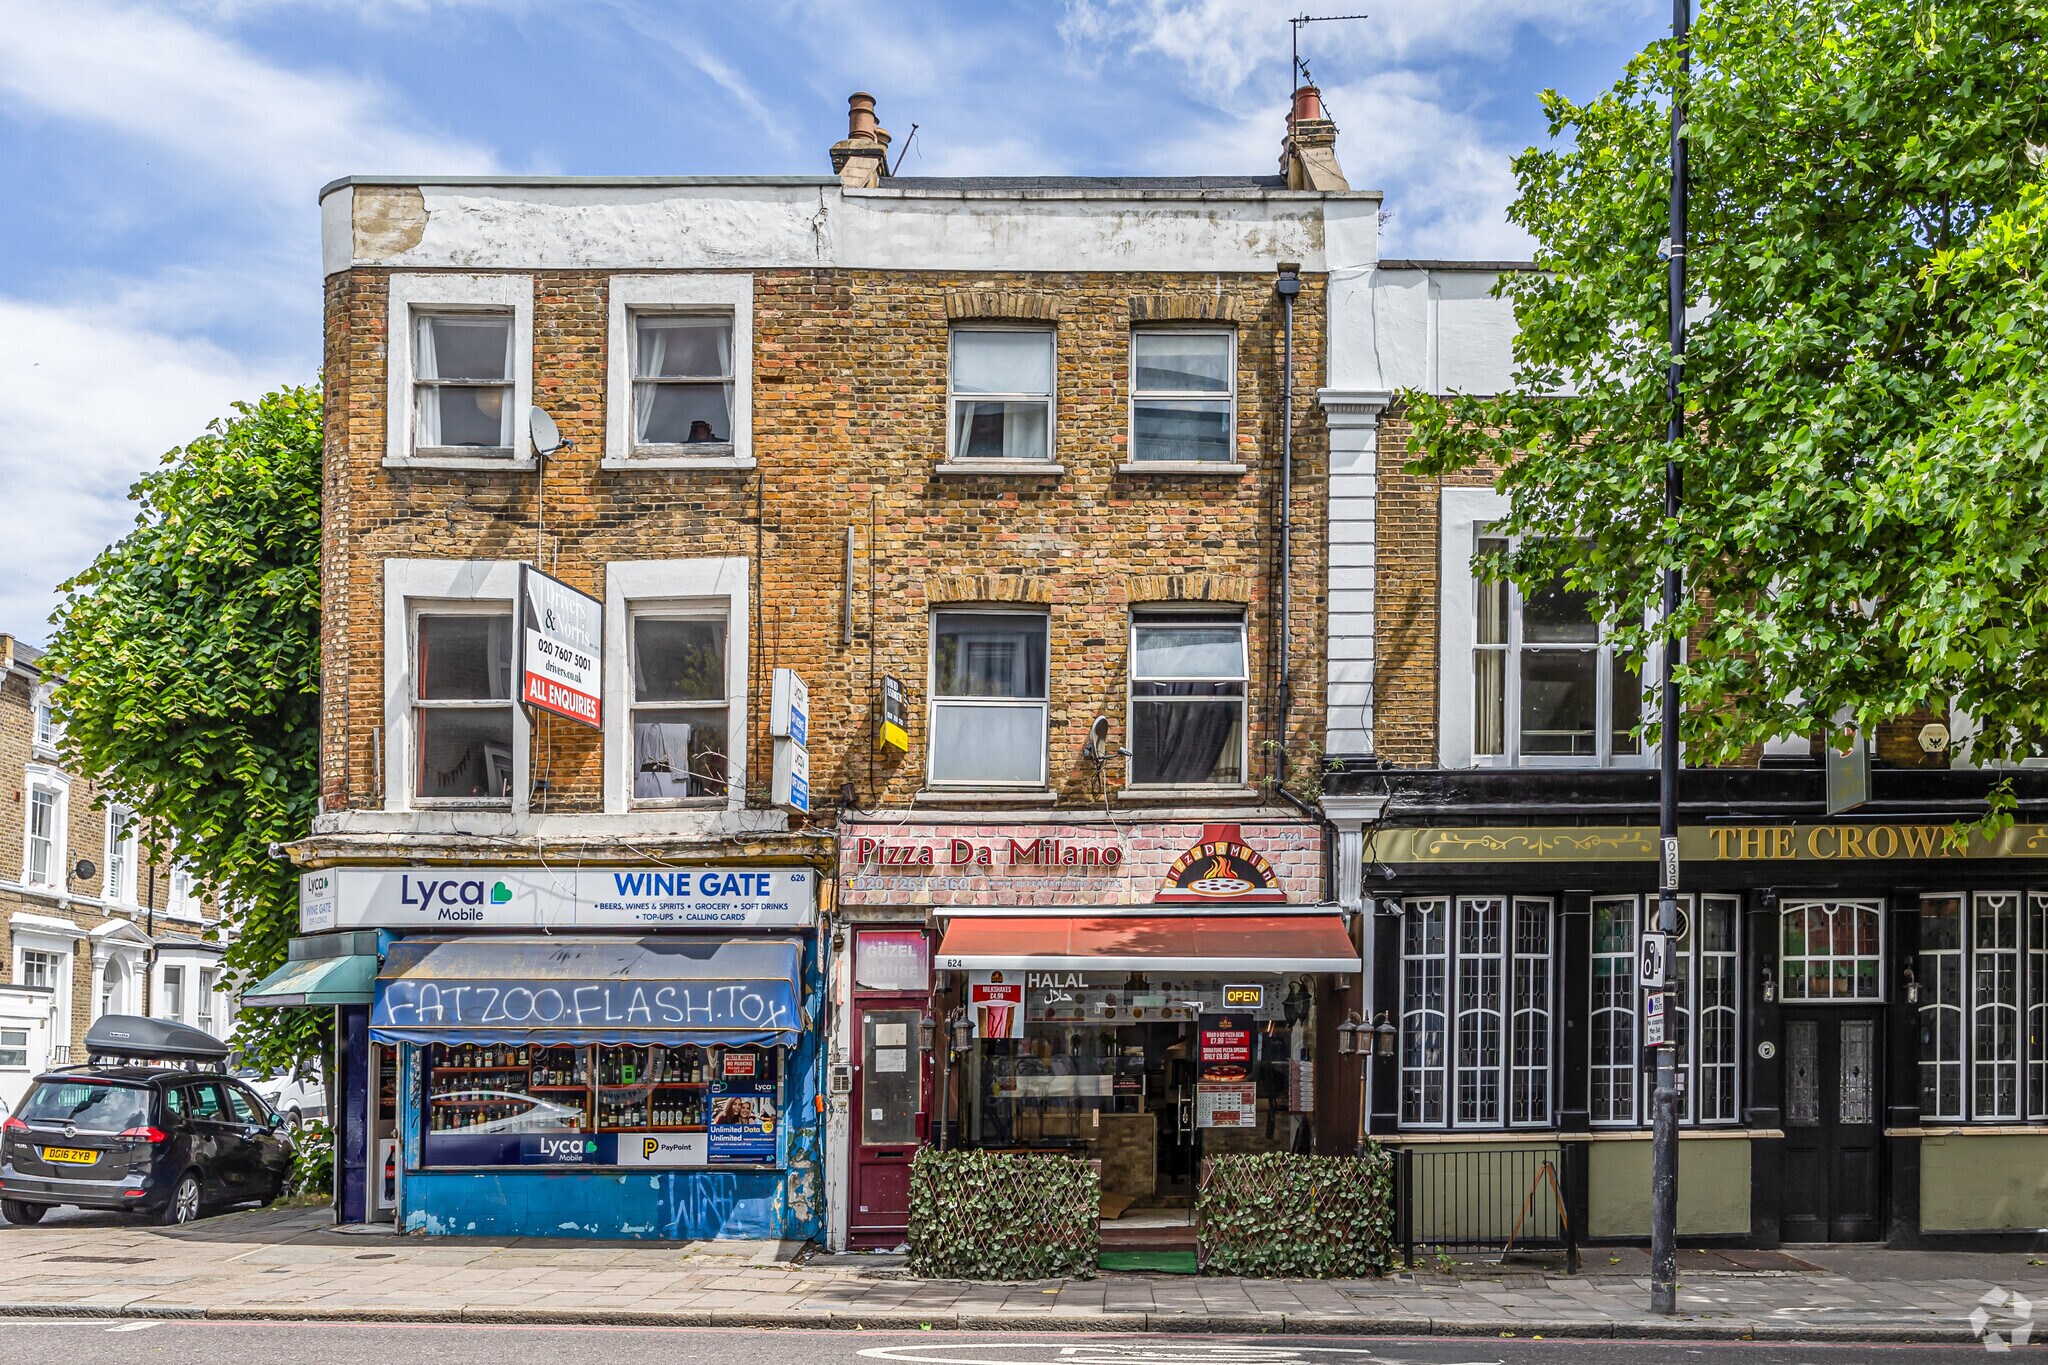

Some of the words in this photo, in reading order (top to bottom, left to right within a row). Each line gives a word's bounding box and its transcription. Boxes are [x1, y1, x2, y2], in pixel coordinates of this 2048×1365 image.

[546, 582, 586, 619] Drivers
[545, 608, 556, 631] &
[556, 611, 590, 647] Norris
[538, 638, 553, 655] 020
[554, 645, 573, 664] 7607
[574, 654, 591, 672] 5001
[545, 660, 582, 684] drivers.co.uk
[530, 677, 547, 701] ALL
[549, 684, 596, 719] ENQUIRIES
[1280, 832, 1300, 840] 624
[1709, 827, 1797, 860] THE
[1808, 826, 1968, 860] CROWN
[857, 838, 934, 865] Pizza
[950, 838, 992, 865] Da
[1008, 838, 1122, 866] Milano
[1166, 850, 1203, 888] Pizza
[1204, 844, 1226, 856] Da
[1230, 846, 1276, 888] Milano
[614, 873, 690, 896] WINE
[700, 873, 770, 896] GATE
[790, 874, 806, 882] 626
[857, 878, 884, 890] 020
[932, 878, 968, 890] 1360
[401, 874, 484, 911] Lyca
[438, 908, 484, 920] Mobile
[600, 903, 624, 911] BEERS,
[866, 941, 918, 958] GÜZEL
[865, 965, 918, 978] HOUSE
[947, 960, 962, 968] 624
[1028, 973, 1089, 988] HALAL
[1043, 988, 1073, 1005] حلال
[1227, 991, 1259, 1002] OPEN
[755, 1083, 772, 1092] Lyca
[49, 1149, 69, 1159] DG16
[71, 1150, 90, 1161] ZYB
[540, 1137, 583, 1156] Lyca
[661, 1144, 692, 1152] PayPoint
